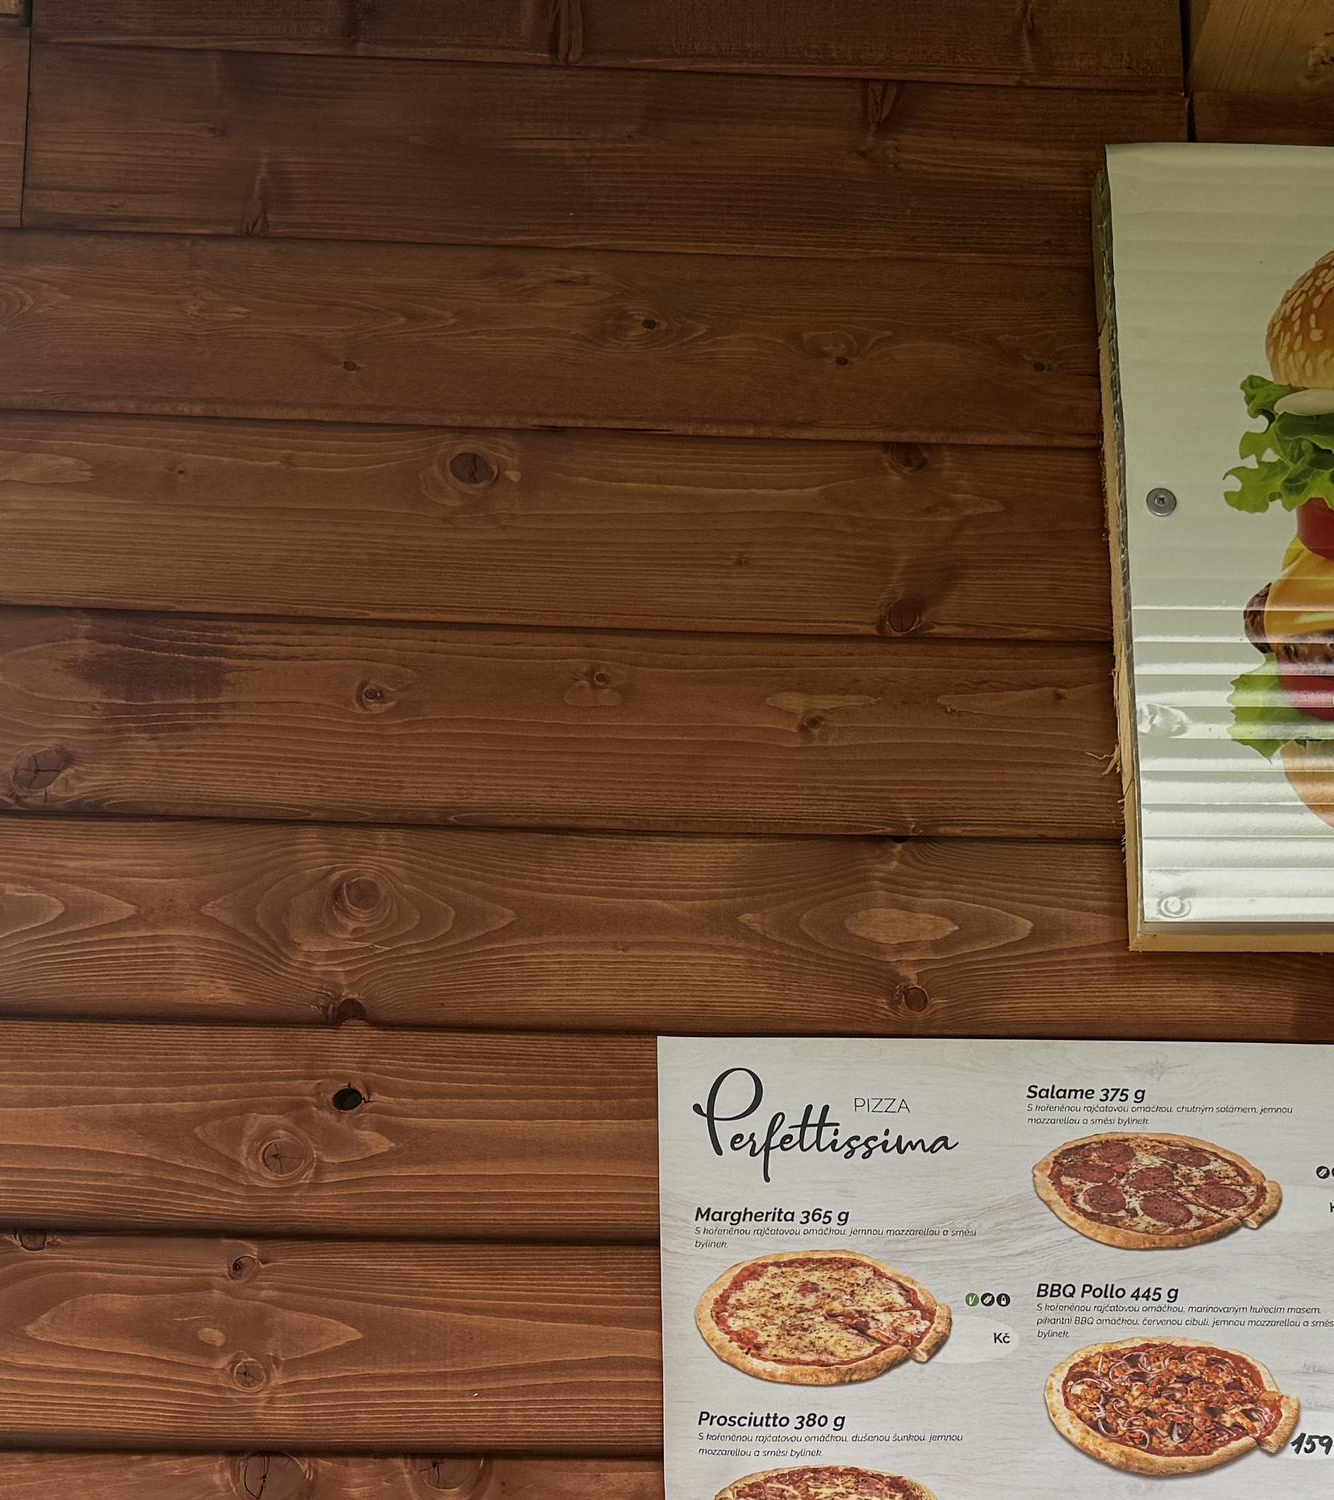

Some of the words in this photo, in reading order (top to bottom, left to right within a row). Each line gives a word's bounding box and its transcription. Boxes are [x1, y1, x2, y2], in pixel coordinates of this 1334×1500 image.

[1027, 1084, 1095, 1100] Salame
[1099, 1088, 1129, 1102] 375
[1134, 1089, 1145, 1103] g
[854, 1097, 910, 1113] PIZZA
[692, 1067, 959, 1183] Perfettissima
[695, 1207, 795, 1226] Margherita
[800, 1209, 832, 1226] 365
[838, 1212, 849, 1227] g
[1036, 1283, 1075, 1299] BBQ
[1081, 1284, 1126, 1299] Pollo
[1131, 1287, 1162, 1301] 445
[1167, 1288, 1179, 1302] g
[993, 1331, 1011, 1344] Kč
[698, 1411, 789, 1428] Prosciutto
[794, 1414, 828, 1430] 380
[834, 1416, 845, 1430] g
